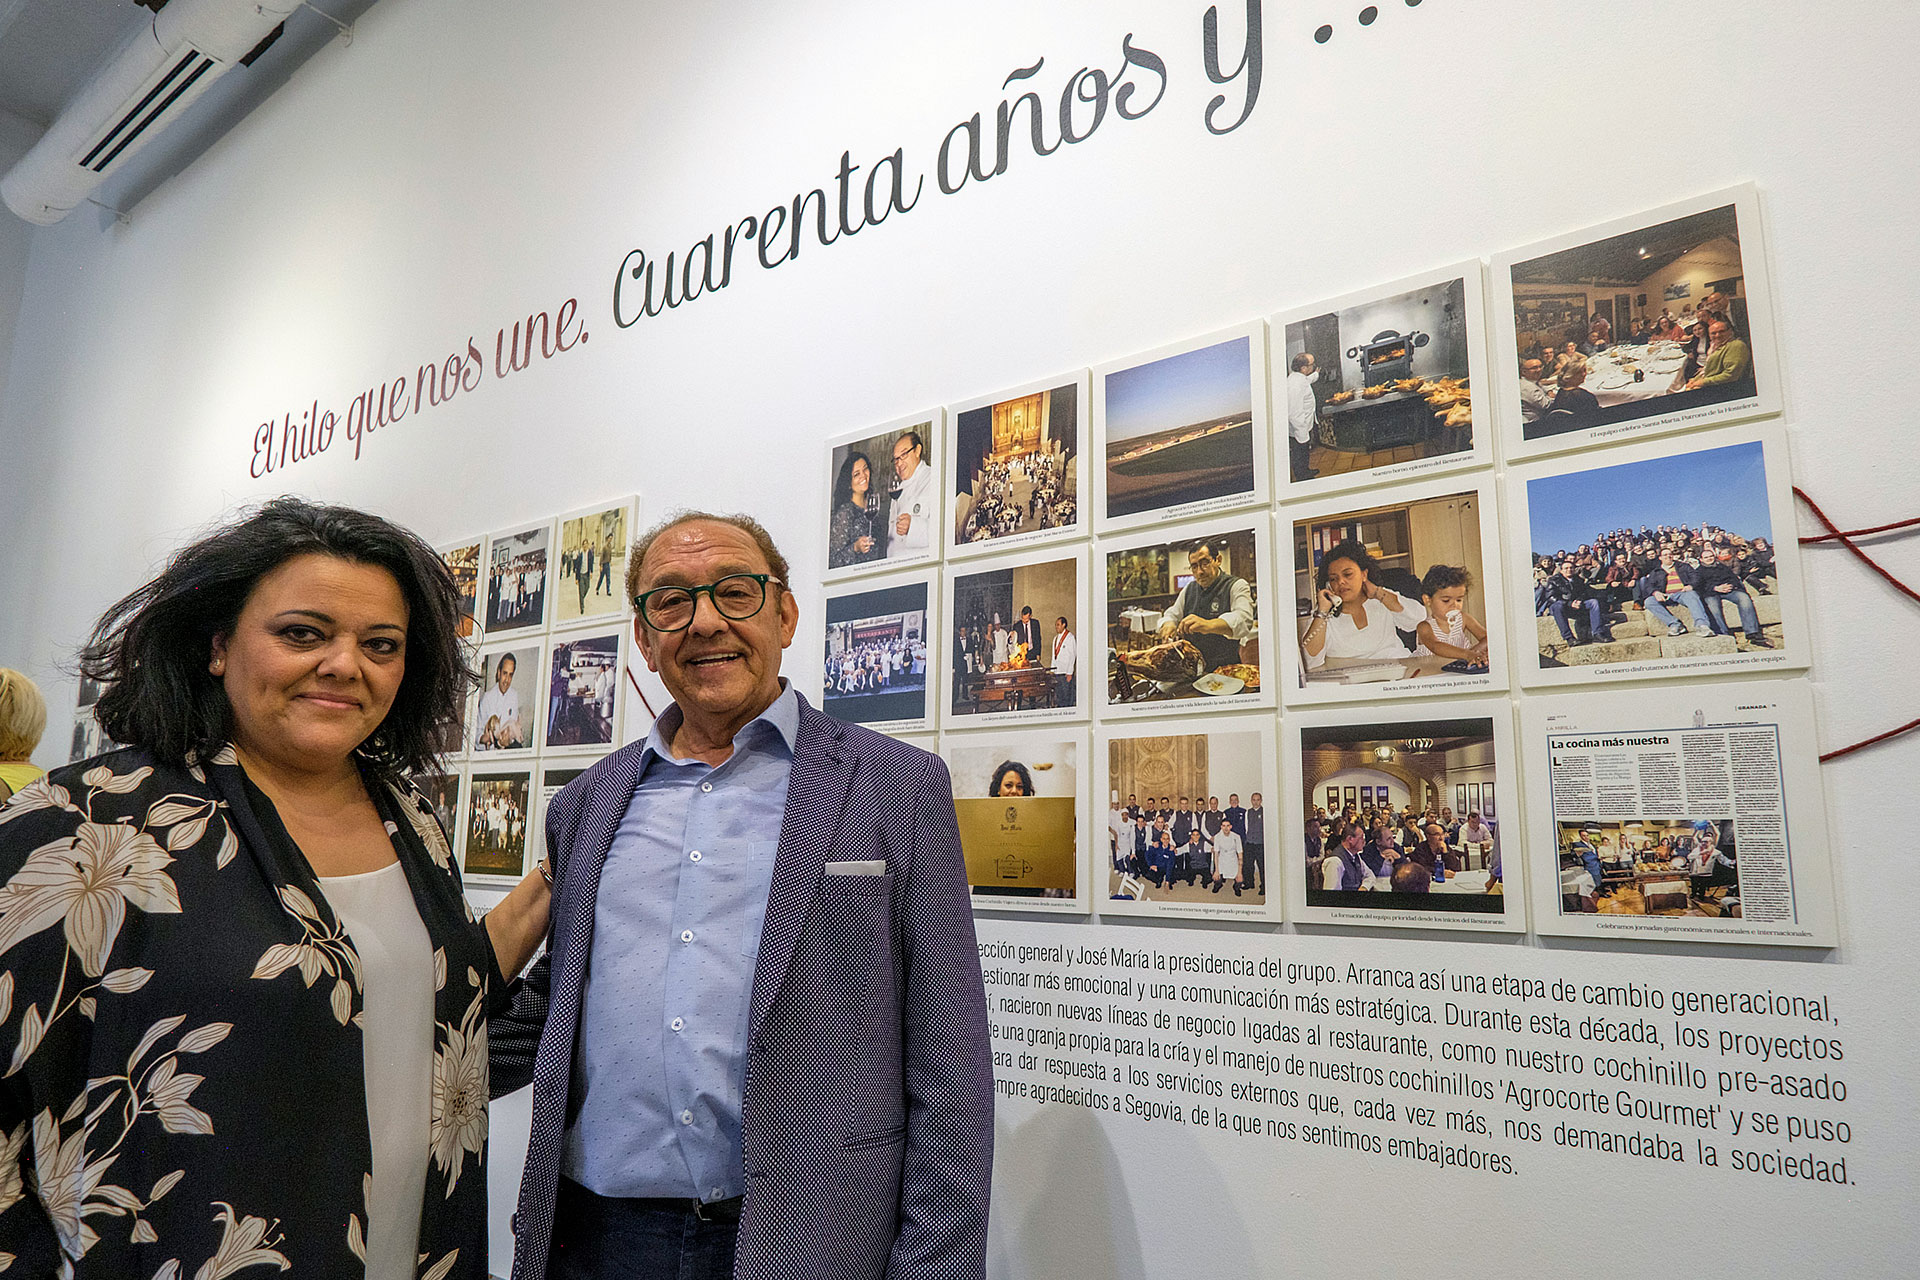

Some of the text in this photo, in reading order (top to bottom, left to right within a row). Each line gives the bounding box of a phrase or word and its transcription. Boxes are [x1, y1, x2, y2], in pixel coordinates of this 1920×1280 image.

[250, 419, 278, 479] El
[279, 399, 342, 469] hilo
[346, 376, 411, 461] que
[414, 336, 483, 415] nos
[495, 297, 589, 379] une.
[612, 146, 924, 329] Cuarenta
[936, 32, 1168, 196] años
[1202, 0, 1263, 136] y
[1551, 735, 1670, 749] La cocina más nuestra
[976, 940, 1839, 1027] ección general y José María la presidencia del grupo. Arranca así una etapa de cambio generacional,
[983, 966, 1844, 1063] estionar más emocional y una comunicación más estratégica. Durante esta década, los proyectos
[999, 995, 1052, 1017] nacieron
[1057, 1003, 1103, 1023] nuevas
[1108, 1003, 1148, 1028] líneas
[1153, 1008, 1171, 1030] de
[1176, 1014, 1236, 1038] negocio
[1243, 1016, 1301, 1044] ligadas
[1307, 1023, 1321, 1046] al
[1329, 1028, 1433, 1062] restaurante,
[1441, 1041, 1497, 1065] como
[1505, 1048, 1584, 1075] nuestro
[1593, 1056, 1707, 1090] cochinillo
[1717, 1071, 1847, 1102] pre-asado
[1002, 1025, 1025, 1042] una
[1026, 1026, 1067, 1050] granja
[1069, 1031, 1112, 1055] propia
[1114, 1038, 1145, 1058] para
[1148, 1037, 1161, 1059] la
[1163, 1040, 1190, 1063] cría
[1192, 1047, 1202, 1068] y
[1205, 1044, 1218, 1066] el
[1222, 1050, 1280, 1077] manejo
[1284, 1053, 1305, 1077] de
[1309, 1060, 1384, 1087] nuestros
[1388, 1068, 1495, 1100] cochinillos
[1499, 1079, 1610, 1115] 'Agrocorte
[1615, 1090, 1721, 1130] Gourmet'
[1729, 1109, 1744, 1136] y
[1751, 1112, 1779, 1135] se
[1786, 1115, 1852, 1144] puso
[1018, 1050, 1039, 1071] dar
[1044, 1058, 1107, 1081] respuesta
[1112, 1067, 1122, 1083] a
[1128, 1064, 1150, 1087] los
[1156, 1072, 1223, 1098] servicios
[1230, 1080, 1299, 1108] externos
[1307, 1093, 1344, 1118] que,
[1353, 1097, 1397, 1122] cada
[1404, 1106, 1437, 1128] vez
[1445, 1109, 1493, 1139] más,
[1504, 1119, 1542, 1143] nos
[1553, 1121, 1685, 1163] demandaba
[1697, 1138, 1719, 1168] la
[1731, 1148, 1856, 1186] sociedad.
[1030, 1083, 1109, 1111] agradecidos
[1112, 1096, 1122, 1113] a
[1124, 1093, 1186, 1126] Segovia,
[1191, 1104, 1210, 1127] de
[1214, 1106, 1228, 1130] la
[1232, 1114, 1262, 1137] que
[1267, 1119, 1297, 1141] nos
[1302, 1124, 1382, 1154] sentimos
[1387, 1136, 1518, 1176] embajadores.
